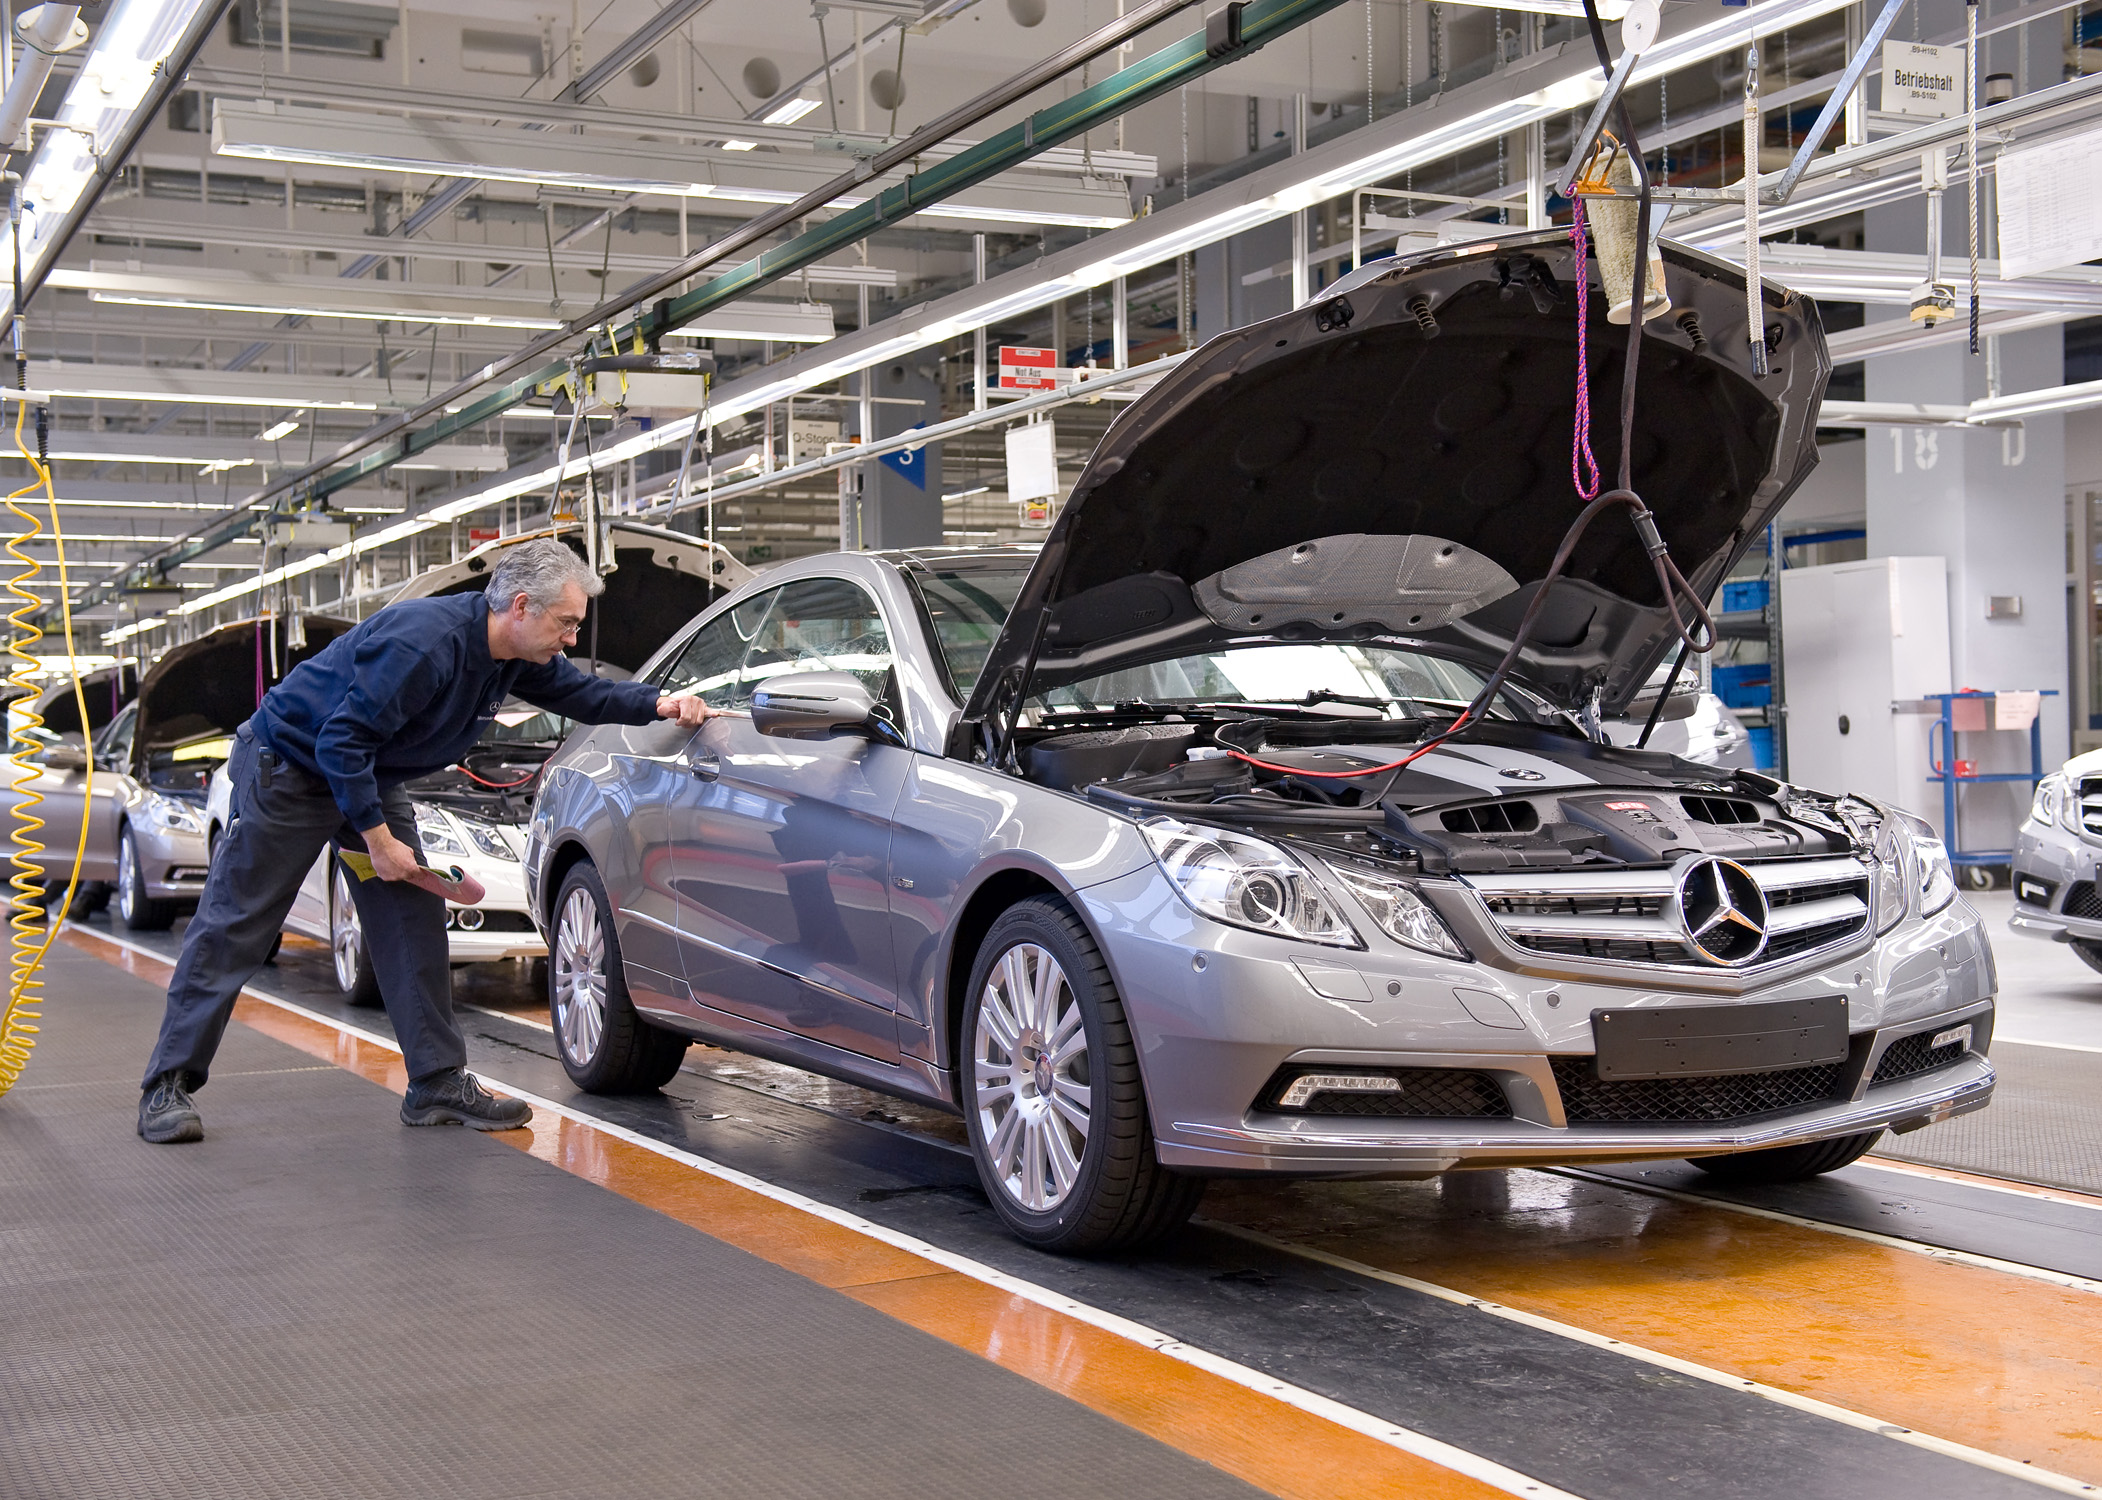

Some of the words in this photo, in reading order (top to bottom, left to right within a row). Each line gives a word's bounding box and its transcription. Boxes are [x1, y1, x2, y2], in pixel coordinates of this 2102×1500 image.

[1895, 69, 1953, 91] Betriebshalt
[1015, 367, 1027, 376] Not
[1029, 368, 1041, 377] Aus
[899, 450, 914, 465] 3
[1890, 428, 1939, 474] 18
